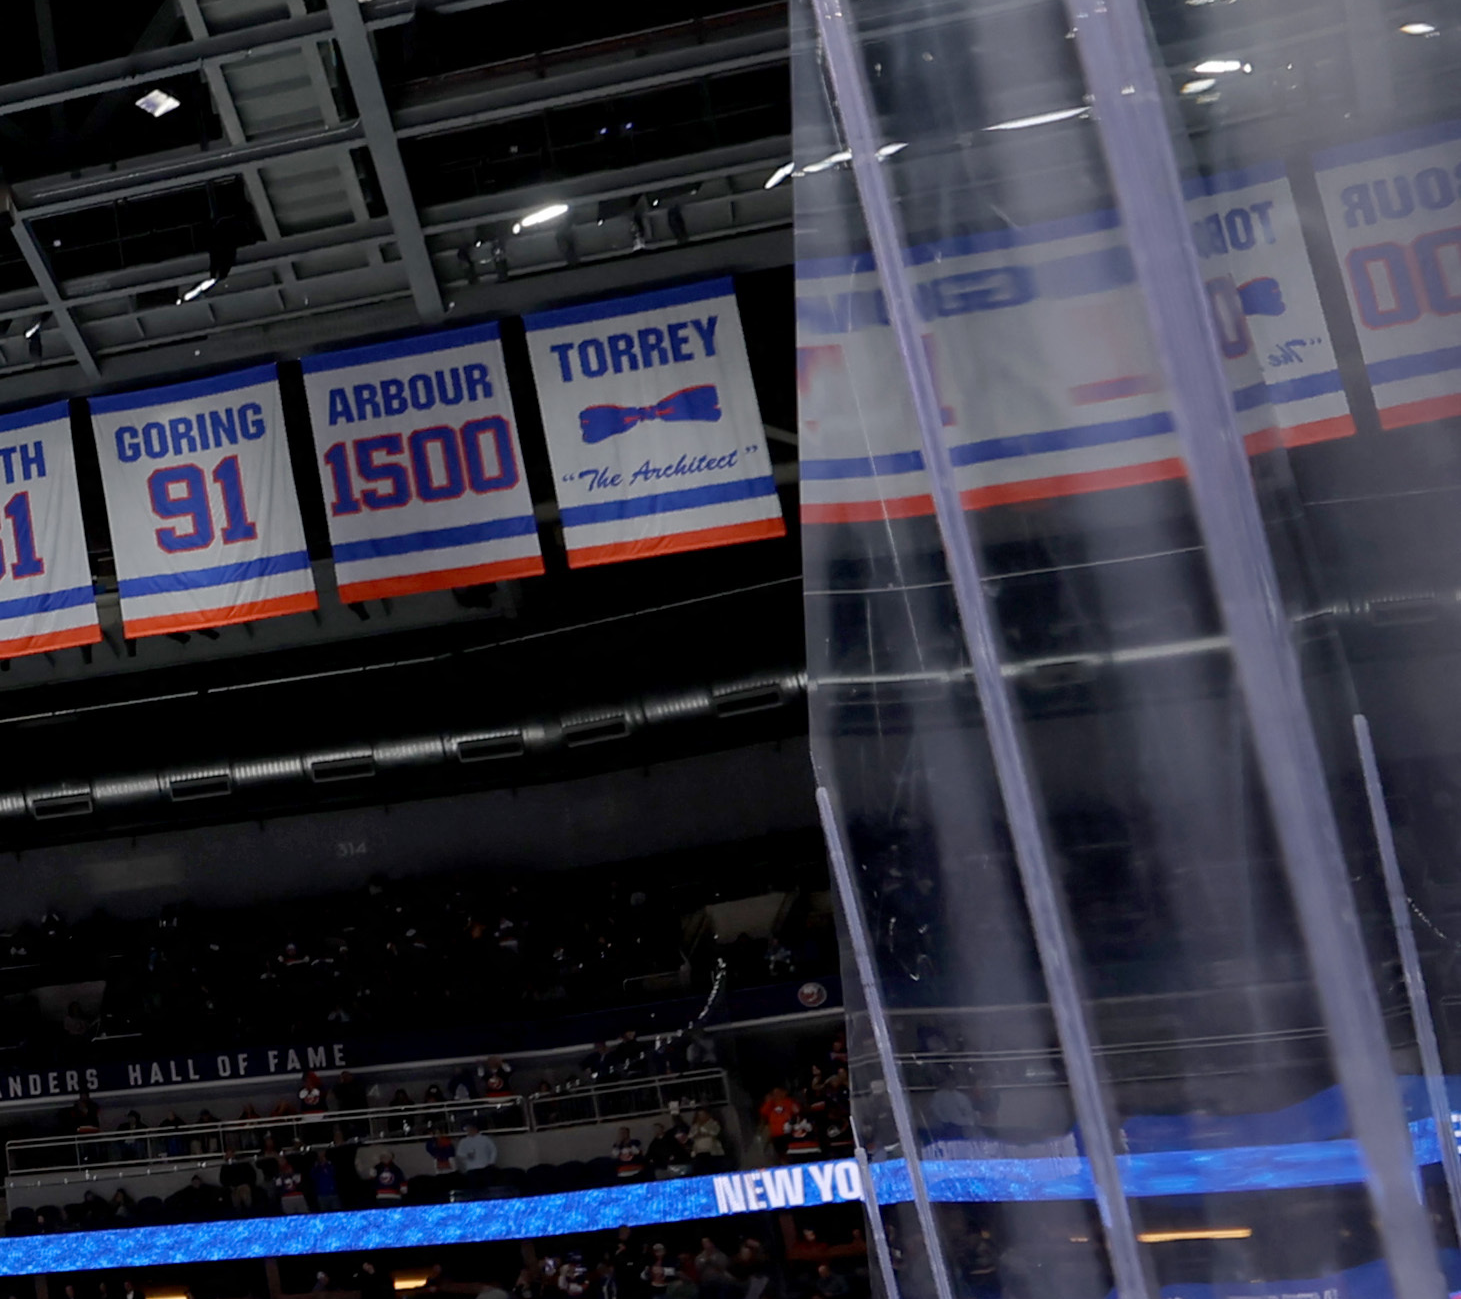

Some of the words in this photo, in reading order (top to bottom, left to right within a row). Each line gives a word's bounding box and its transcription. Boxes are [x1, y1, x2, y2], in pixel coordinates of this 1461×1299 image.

[550, 315, 721, 385] TORREY
[327, 361, 496, 427] ARBOUR
[116, 402, 267, 464] GORING
[323, 415, 521, 517] 1500
[147, 454, 258, 555] 91
[128, 1058, 200, 1088] HALL
[217, 1050, 251, 1077] OF
[267, 1043, 347, 1073] FAME
[714, 1163, 804, 1214] NEW
